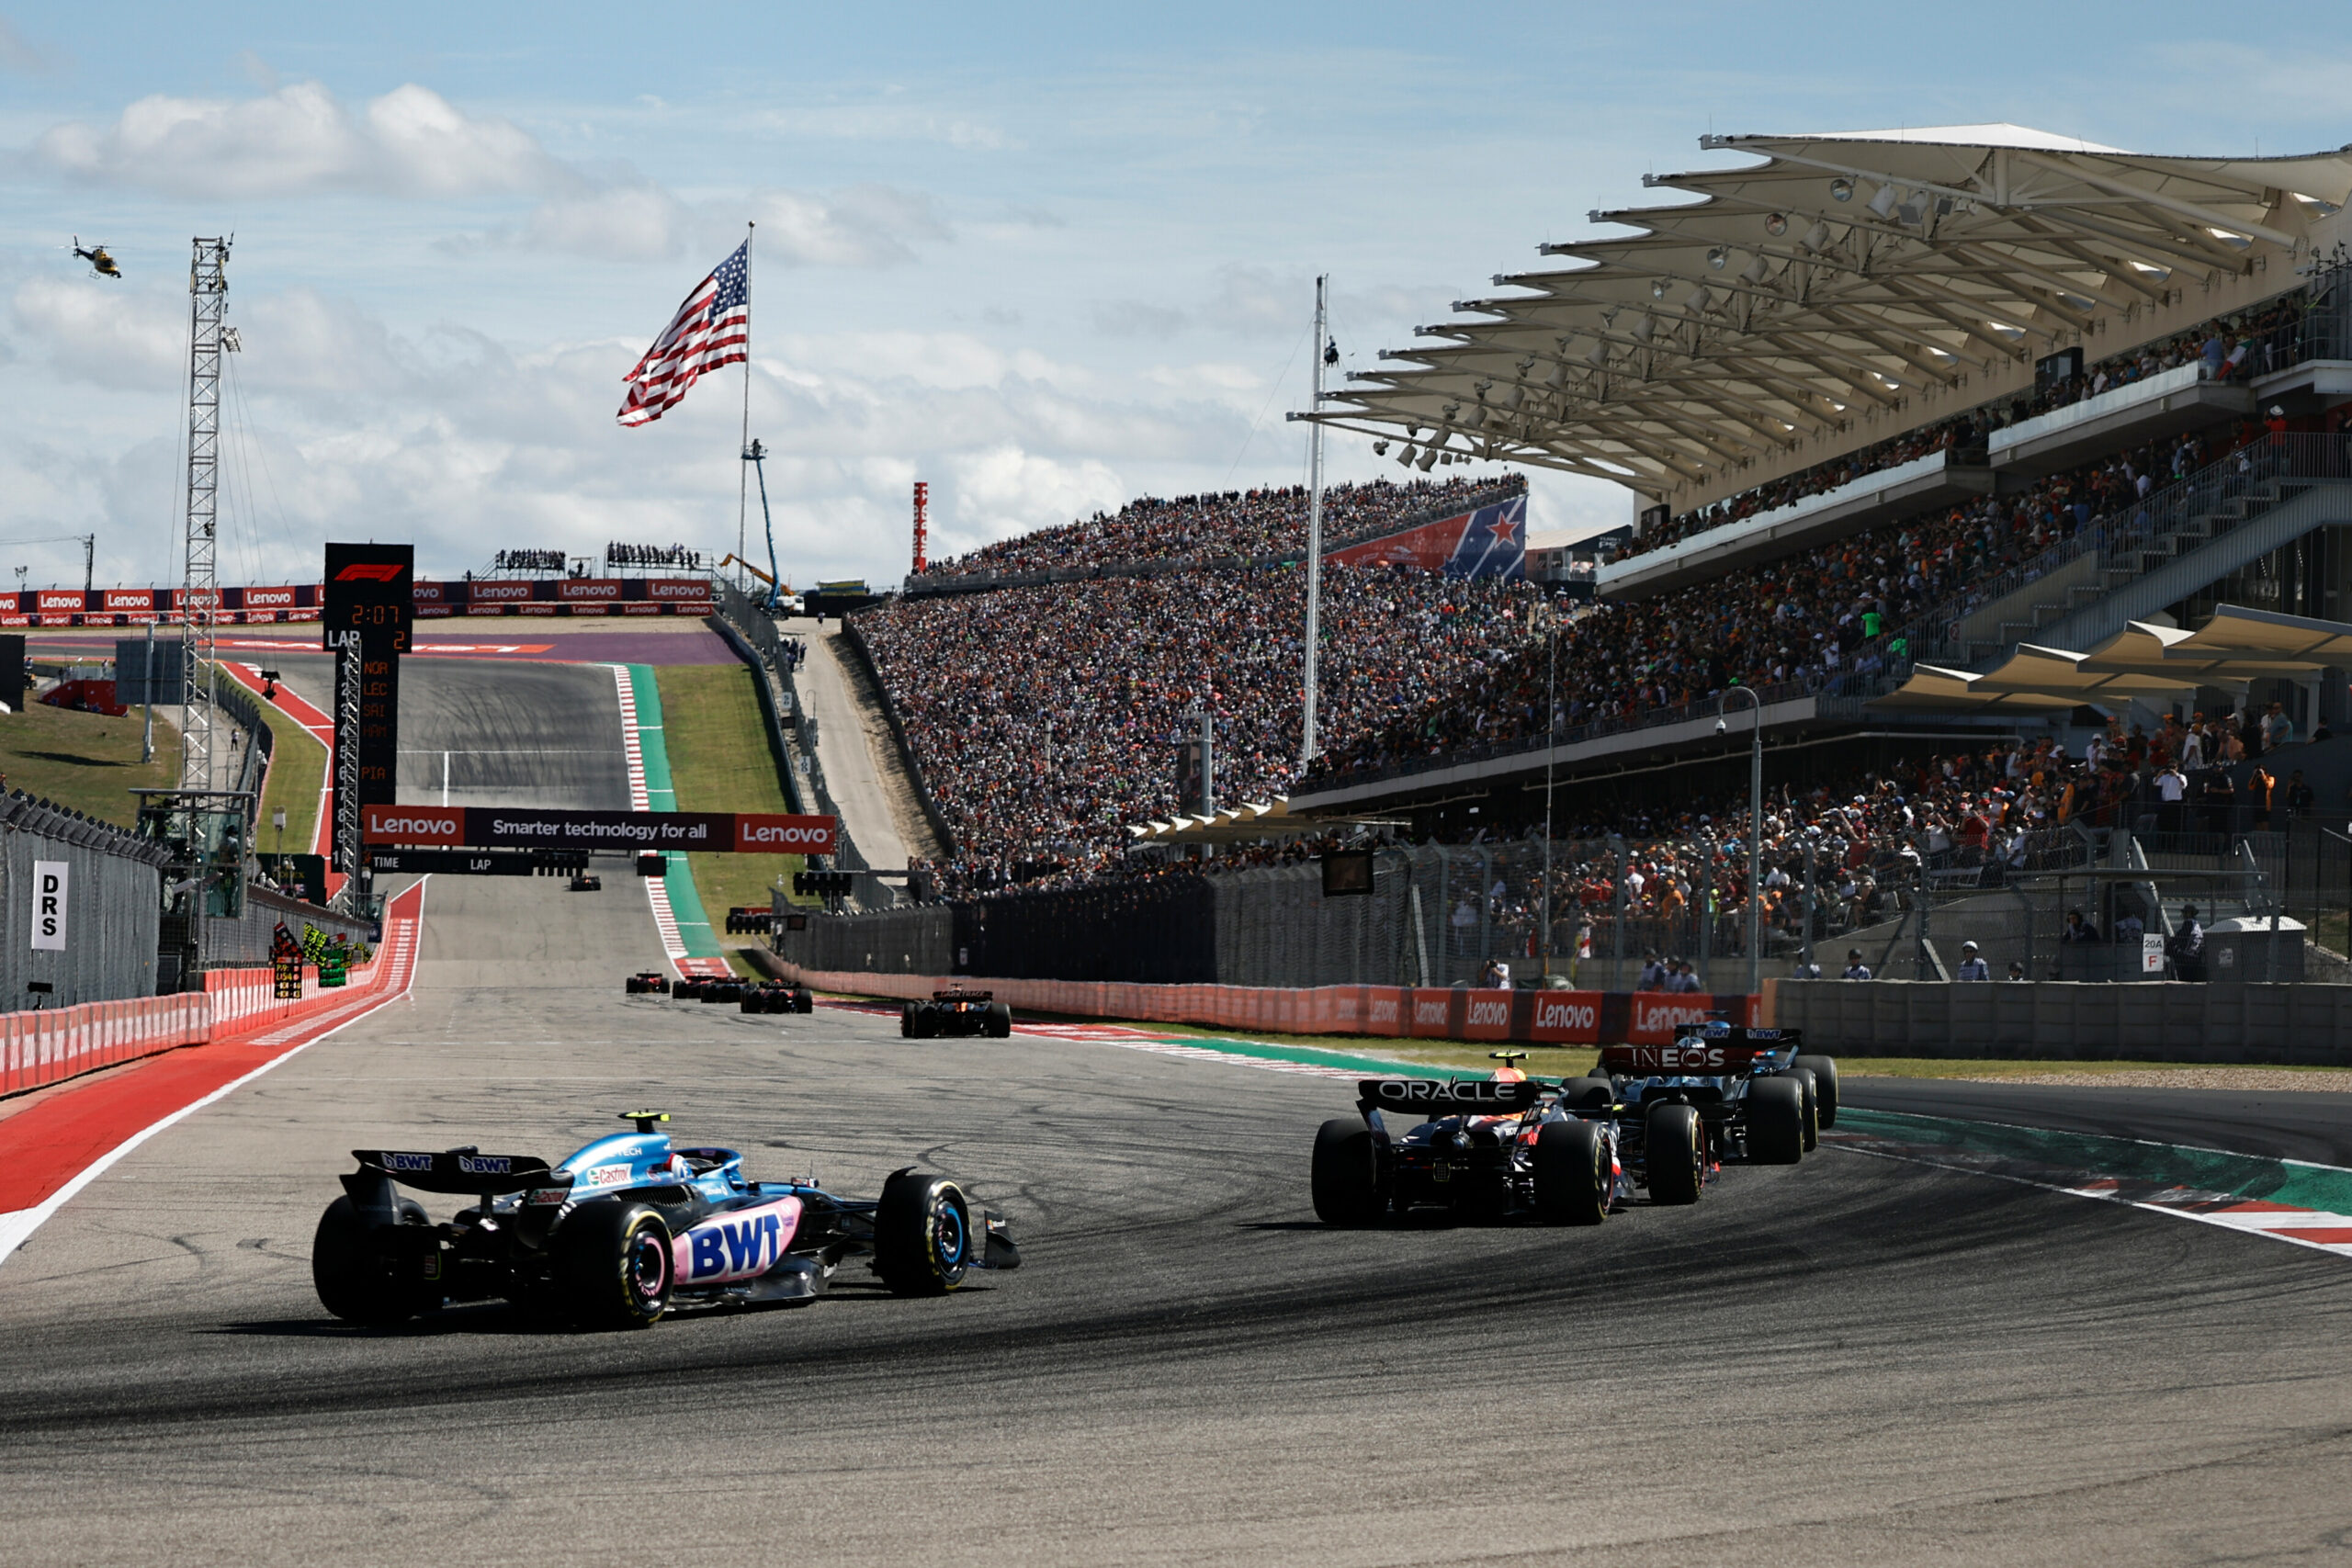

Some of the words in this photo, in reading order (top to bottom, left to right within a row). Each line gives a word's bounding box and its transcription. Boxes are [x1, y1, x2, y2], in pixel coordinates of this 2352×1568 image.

[413, 588, 439, 598] ovo
[474, 586, 528, 597] Lenovo
[563, 583, 616, 595] Lenovo
[651, 583, 705, 596] Lenovo
[40, 594, 82, 608] Lenovo
[107, 593, 150, 607] Lenovo
[246, 592, 291, 604] Lenovo
[352, 605, 399, 625] 2:07
[520, 604, 553, 614] Lenovo
[625, 604, 658, 613] Lenovo
[676, 604, 710, 613] Lenovo
[328, 630, 360, 648] LAP
[393, 630, 405, 650] 2
[364, 661, 389, 675] NOR
[363, 682, 388, 696] LEC
[371, 814, 457, 835] Lenovo
[492, 819, 560, 835] Smarter
[565, 821, 658, 840] technology
[661, 822, 686, 838] for
[688, 823, 707, 839] all
[743, 823, 828, 843] Lenovo
[373, 856, 399, 868] TIME
[470, 859, 492, 871] LAP
[42, 874, 59, 936] DRS
[2144, 940, 2163, 949] 20A
[2148, 955, 2158, 968] F
[1468, 995, 1508, 1026] Lenovo
[1536, 998, 1594, 1029] Lenovo
[1637, 1001, 1705, 1031] Lenovo
[1756, 1030, 1781, 1039] BWT
[1632, 1048, 1725, 1067] INEOS
[1379, 1081, 1517, 1100] ORACLE
[394, 1154, 433, 1171] BWT
[471, 1156, 512, 1174] BWT
[599, 1167, 629, 1186] Castrol
[690, 1213, 782, 1280] BWT
